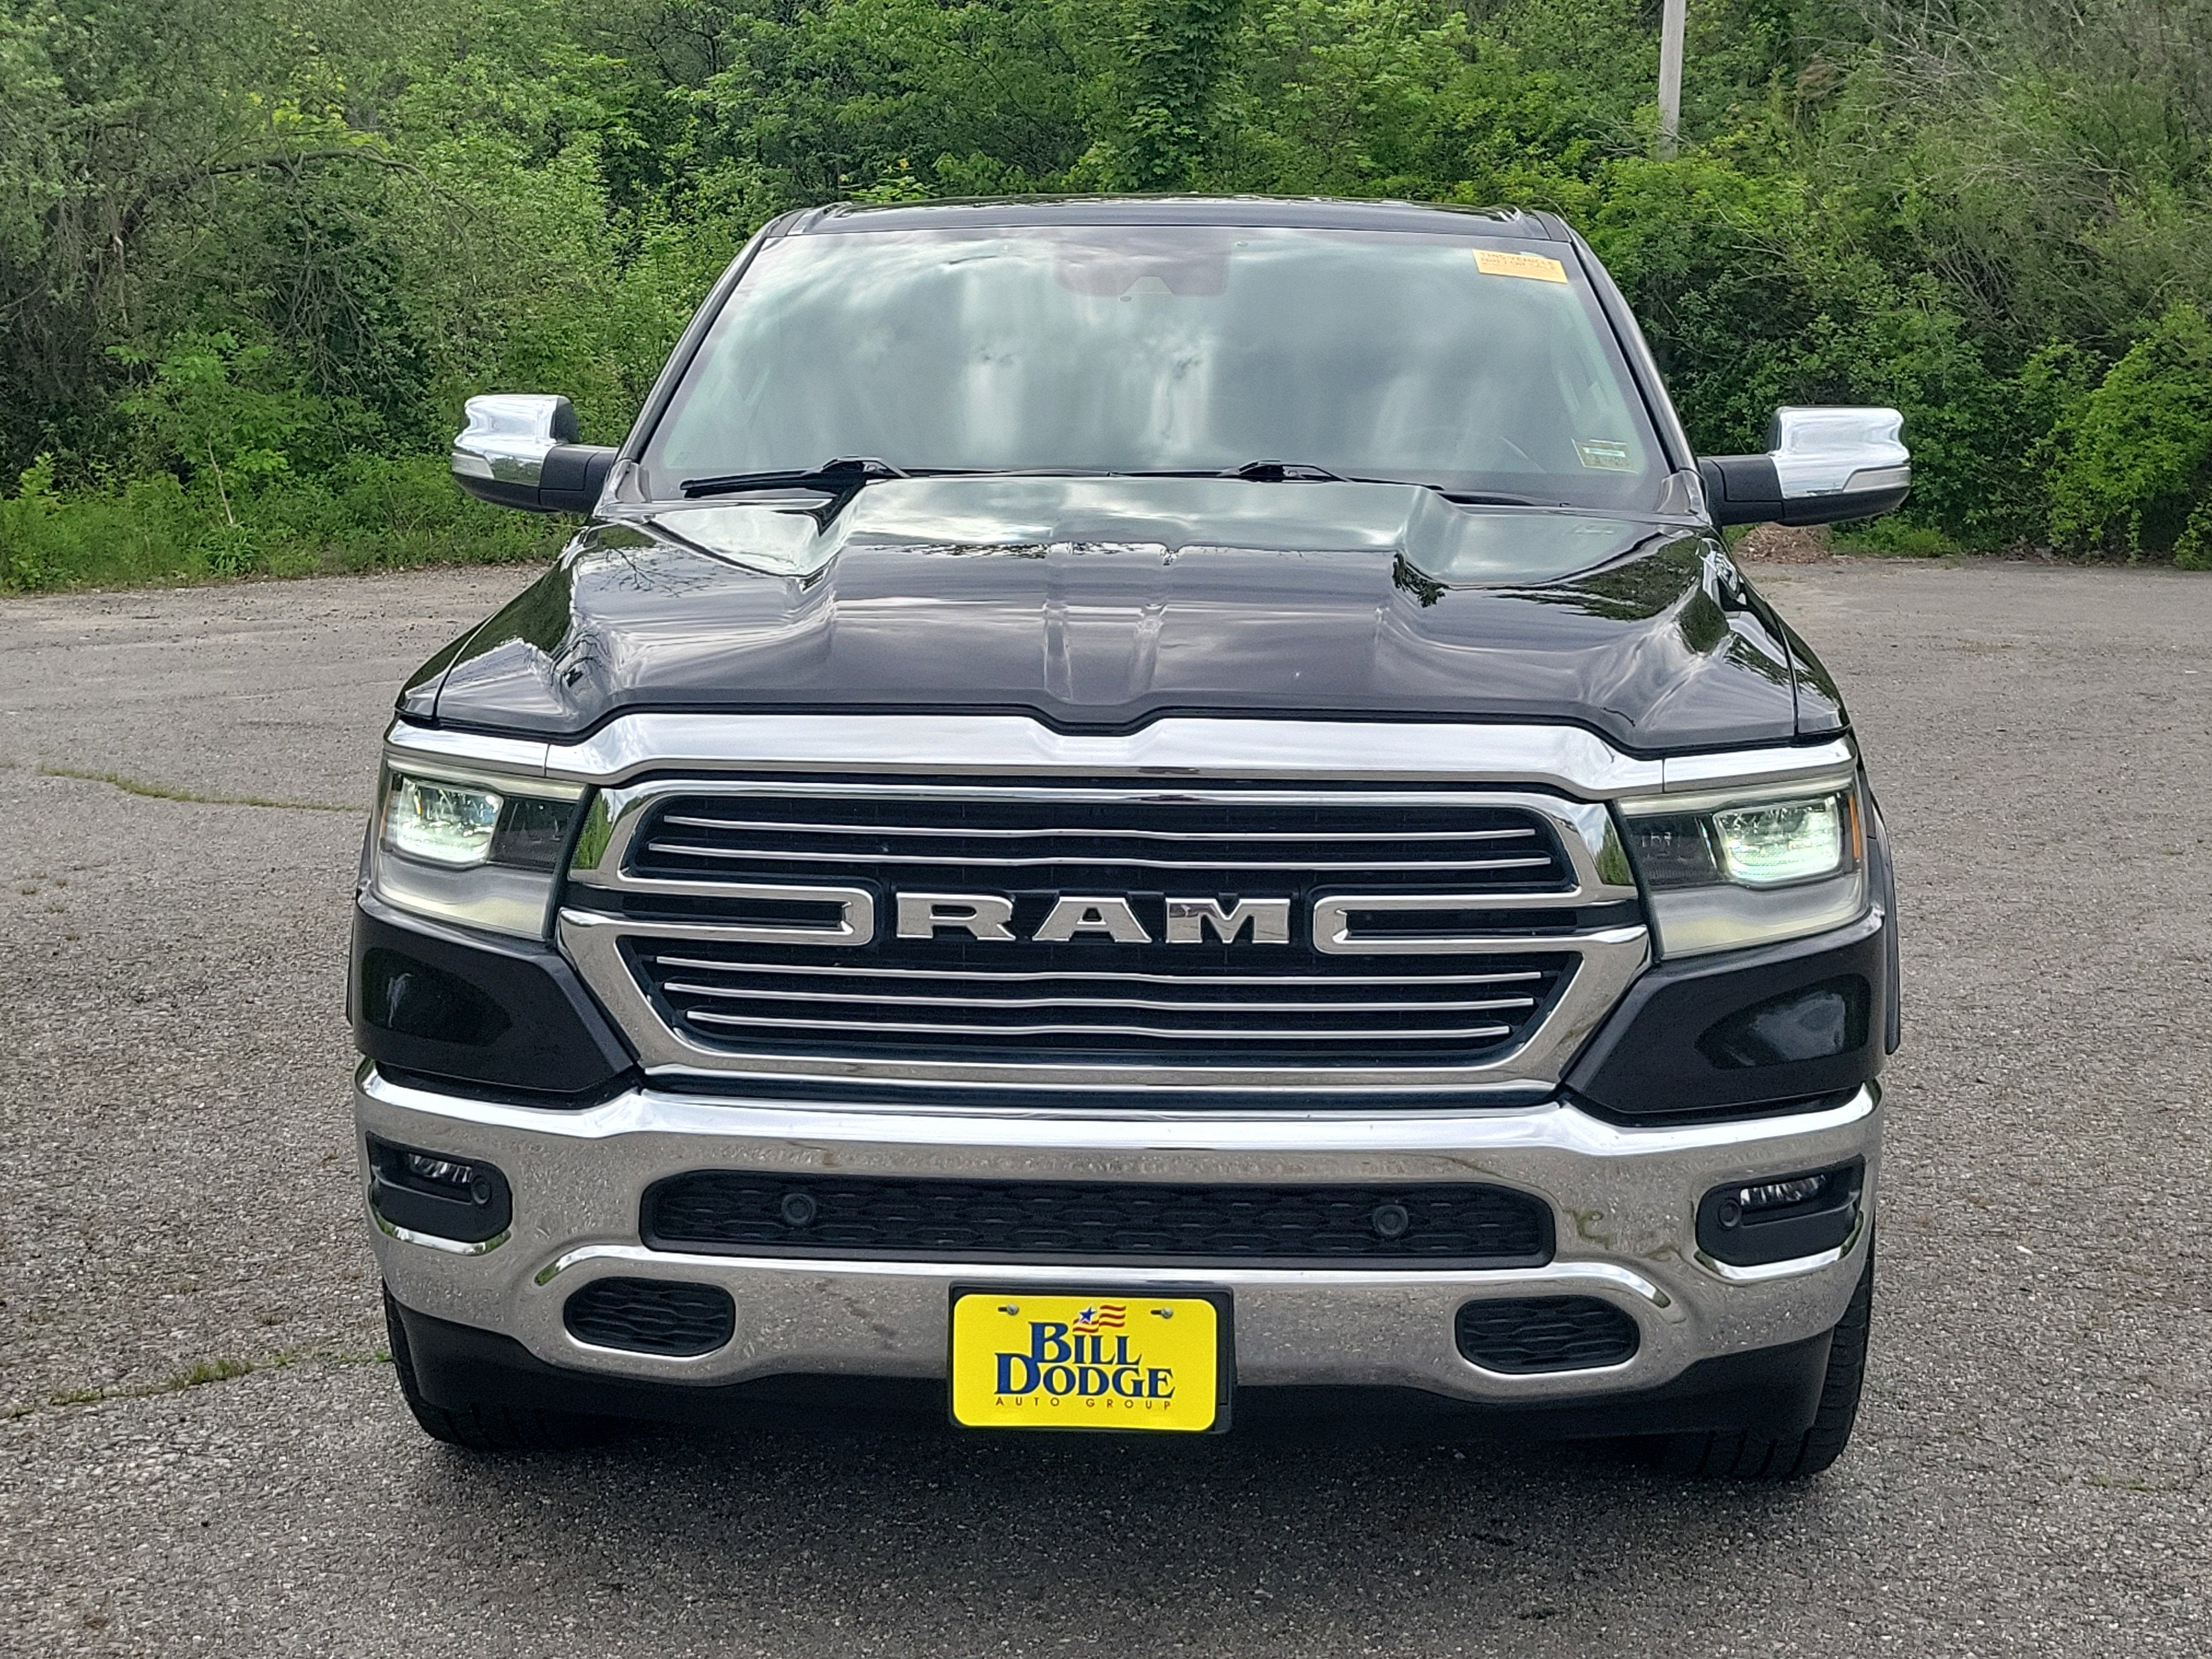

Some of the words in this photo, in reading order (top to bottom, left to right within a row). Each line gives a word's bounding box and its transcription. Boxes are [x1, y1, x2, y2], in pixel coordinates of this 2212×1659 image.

[895, 892, 1290, 944] RAM
[1028, 1321, 1142, 1365] BILL
[994, 1352, 1175, 1398] DODGE
[995, 1398, 1060, 1407] AUTO
[1086, 1399, 1171, 1410] GROUP
